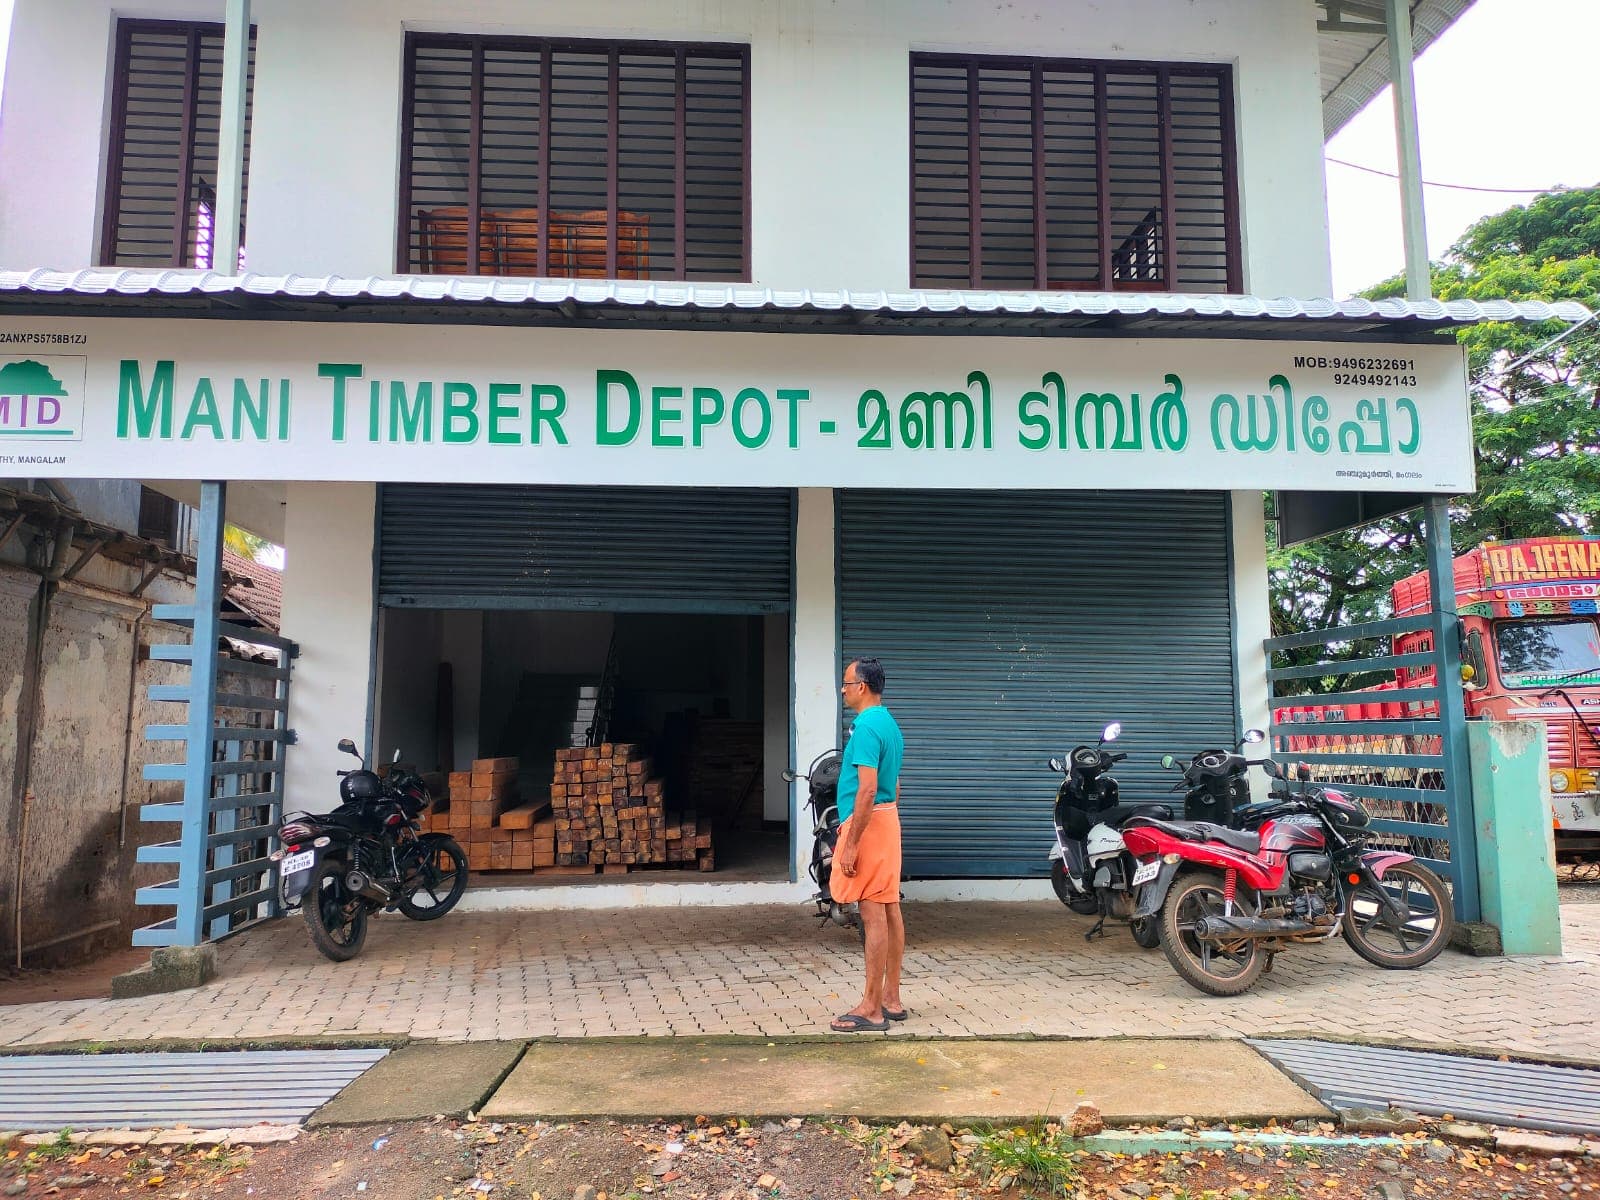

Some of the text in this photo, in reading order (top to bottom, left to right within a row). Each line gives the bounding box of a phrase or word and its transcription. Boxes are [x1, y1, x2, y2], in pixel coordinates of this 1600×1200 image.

[0, 333, 87, 345] 2ANXPS5758B1ZJ
[1293, 356, 1416, 371] MOB:9496232691
[1334, 373, 1417, 387] 9249492143
[116, 359, 289, 440] MANI
[318, 363, 569, 446] TIMBER
[857, 370, 1420, 455] മണി ടിമ്പർ ഡിപ്പോ
[18, 455, 66, 464] MANGALAM
[1510, 585, 1583, 599] GOODS
